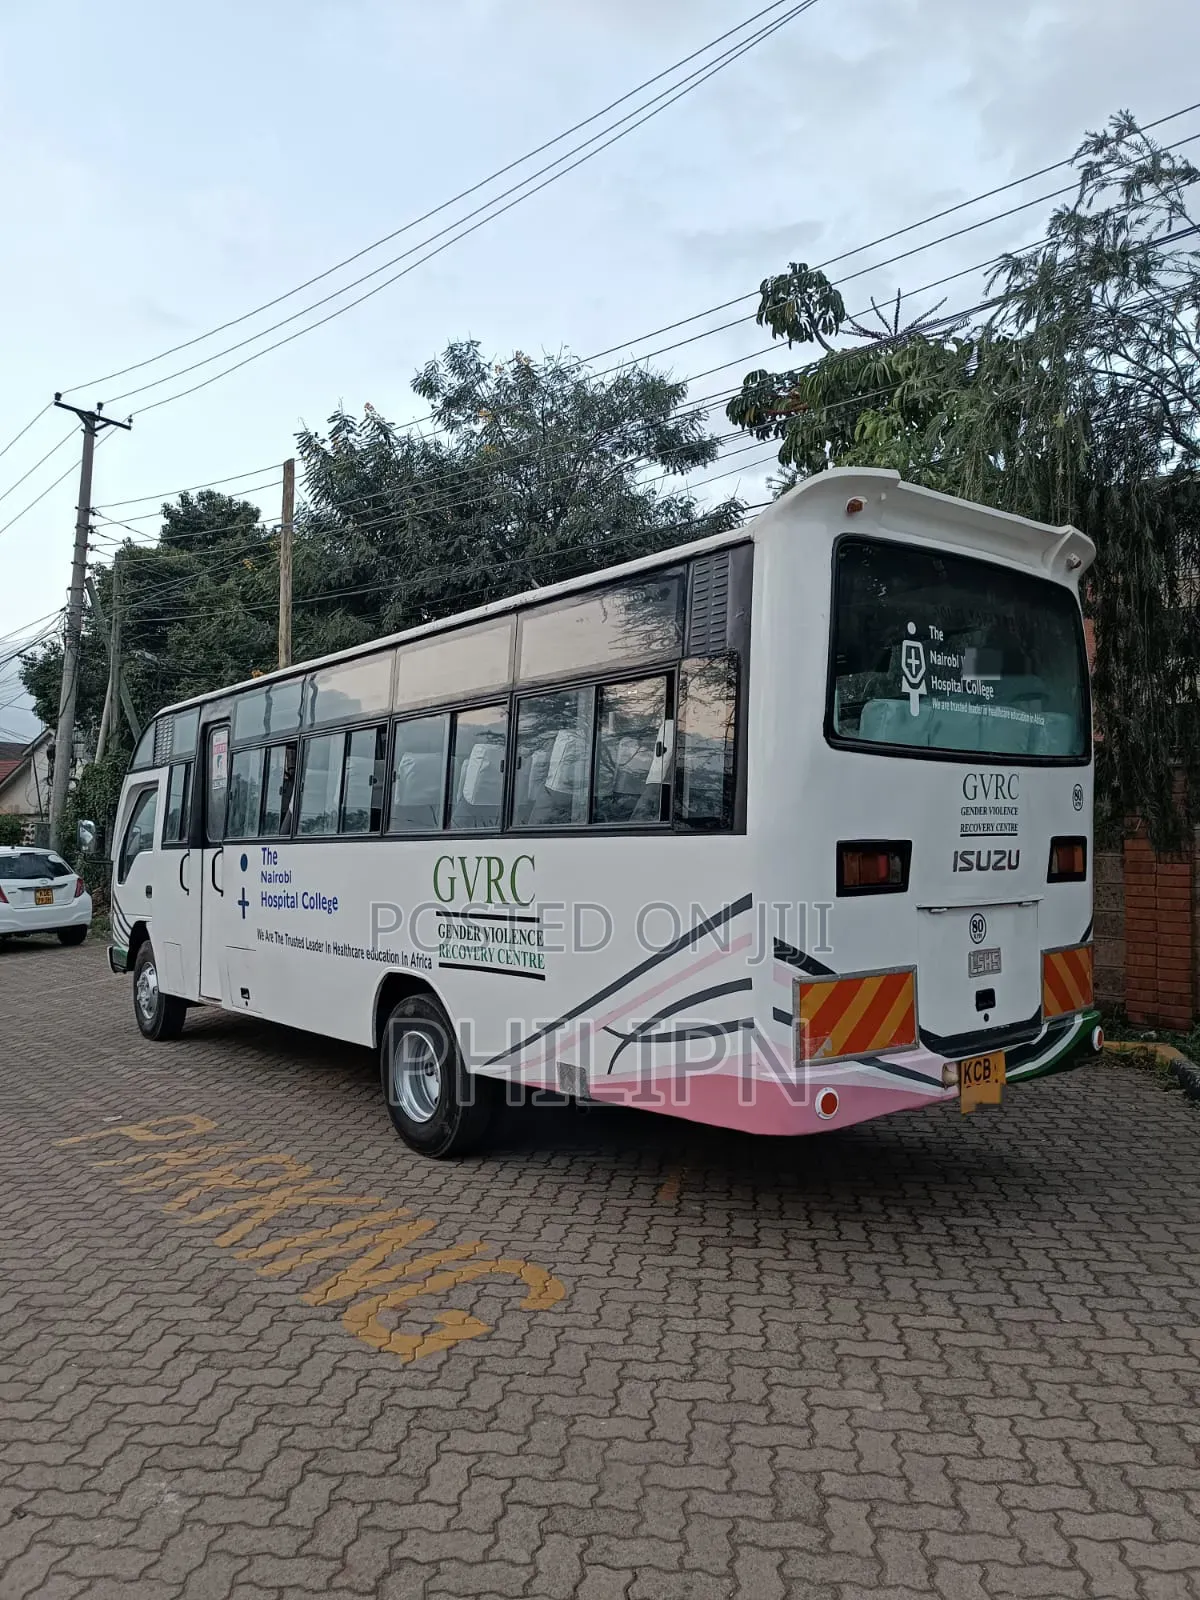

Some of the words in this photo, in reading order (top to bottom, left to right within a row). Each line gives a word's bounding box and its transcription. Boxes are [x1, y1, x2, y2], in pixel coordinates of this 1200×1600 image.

[928, 625, 944, 641] The
[930, 650, 959, 668] Nairobi
[931, 675, 964, 697] Hospital
[965, 679, 995, 701] College
[962, 773, 1020, 801] GVRC
[960, 806, 988, 816] GENDER
[988, 806, 1019, 816] VIOLENCE
[960, 823, 995, 833] RECOVERY
[995, 822, 1019, 833] CENTRE
[261, 847, 278, 866] The
[952, 849, 1020, 873] ISUZU
[260, 870, 292, 884] Nairobi
[433, 855, 535, 907] GVRC
[260, 889, 299, 911] Hospital
[301, 891, 339, 915] College
[438, 923, 482, 942] GENDER
[483, 926, 544, 948] VIOLENCE
[972, 919, 984, 934] 80
[257, 928, 265, 941] We
[265, 929, 274, 944] Are
[274, 931, 284, 945] The
[284, 932, 305, 949] Trusted
[305, 936, 324, 953] Leader
[325, 940, 332, 955] In
[332, 941, 365, 960] Healthcare
[366, 946, 399, 964] education
[401, 950, 409, 967] In
[410, 951, 433, 970] Africa
[438, 943, 496, 963] RECOVERY
[497, 948, 545, 970] CENTRE
[963, 1058, 991, 1085] KCB
[53, 1113, 566, 1364] PARKING
